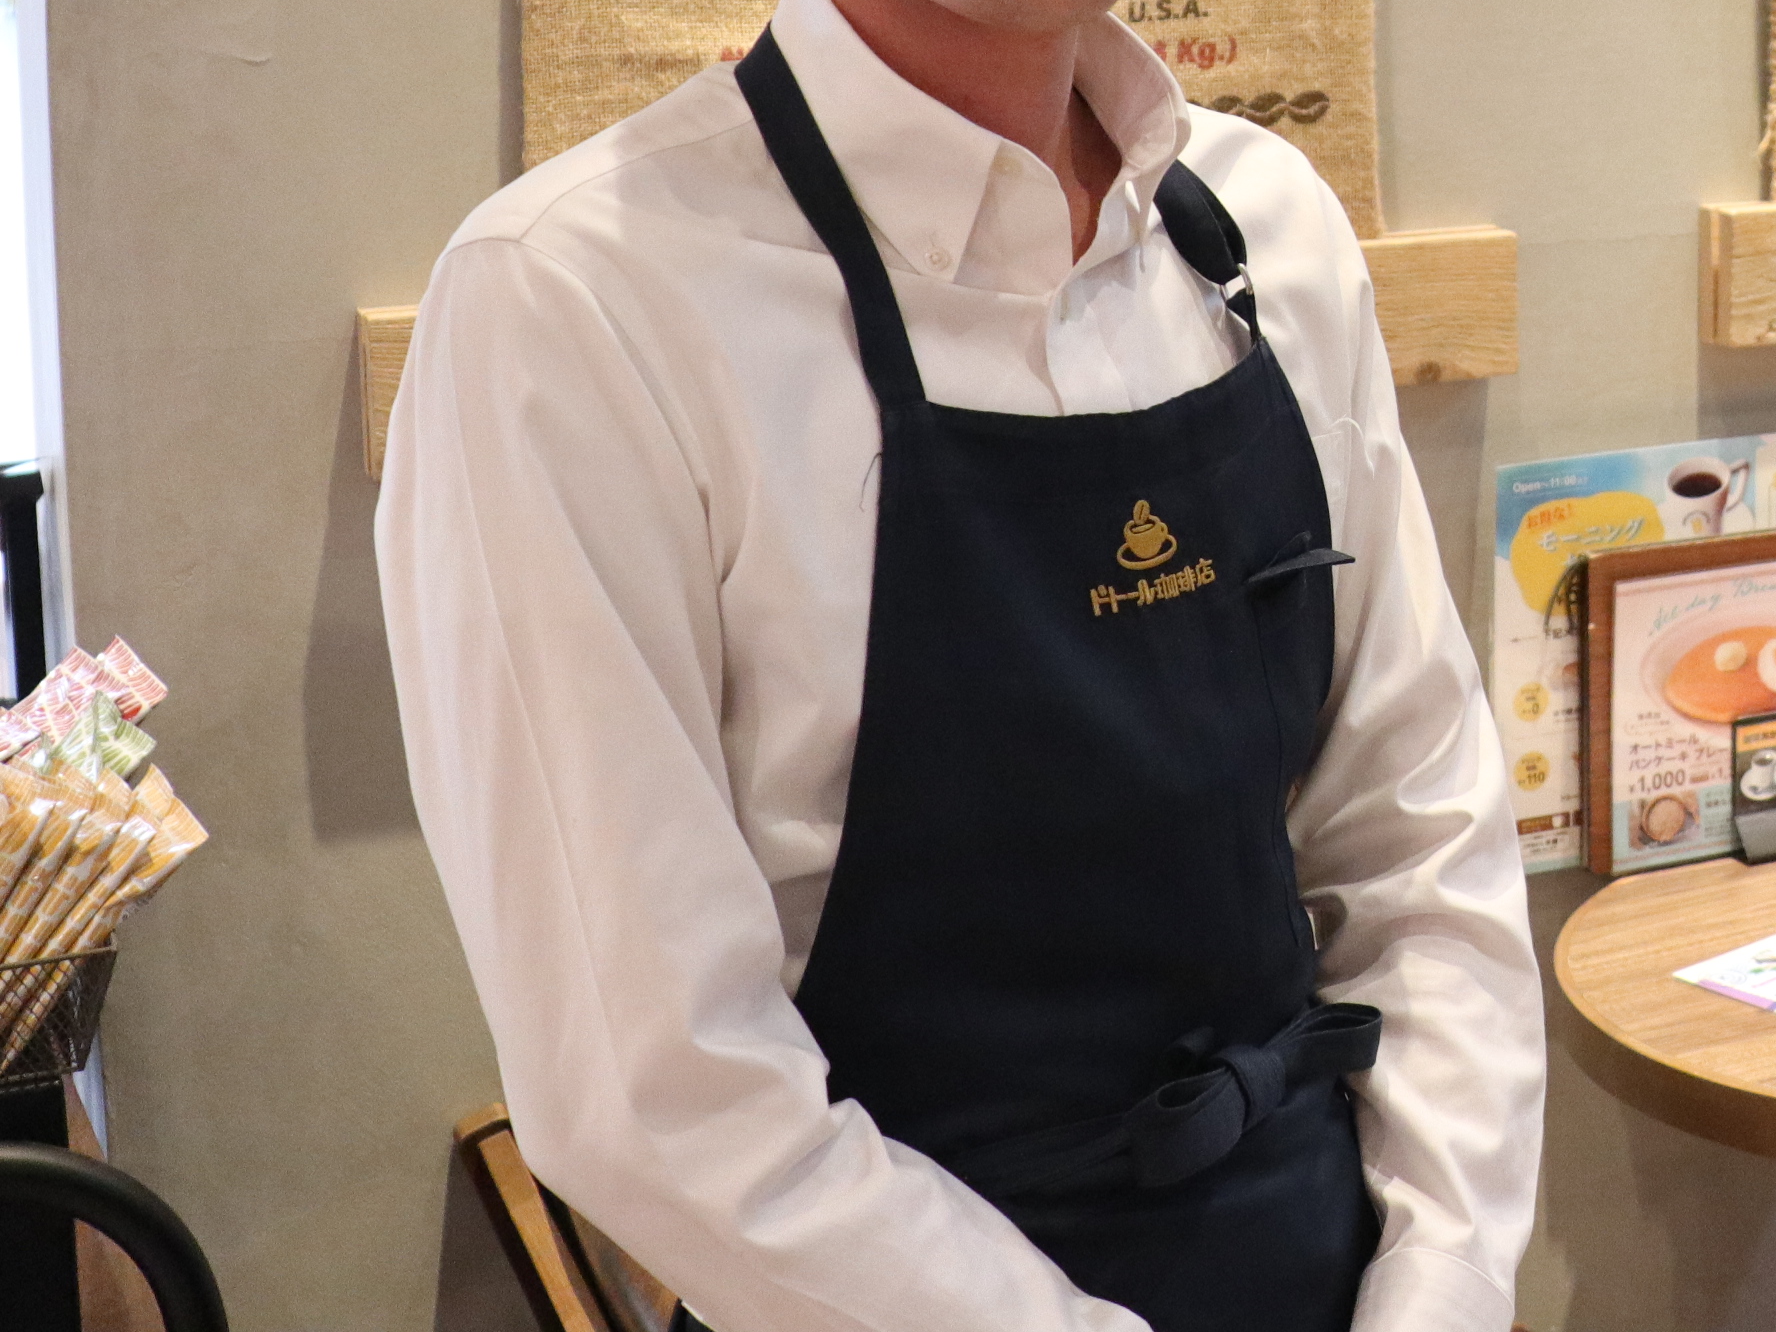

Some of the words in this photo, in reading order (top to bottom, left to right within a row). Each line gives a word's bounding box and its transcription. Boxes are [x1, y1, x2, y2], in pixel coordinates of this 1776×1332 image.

[1539, 517, 1645, 552] モーニング
[1090, 558, 1216, 616] ドトール珈琲店
[1629, 734, 1700, 755] オートミール
